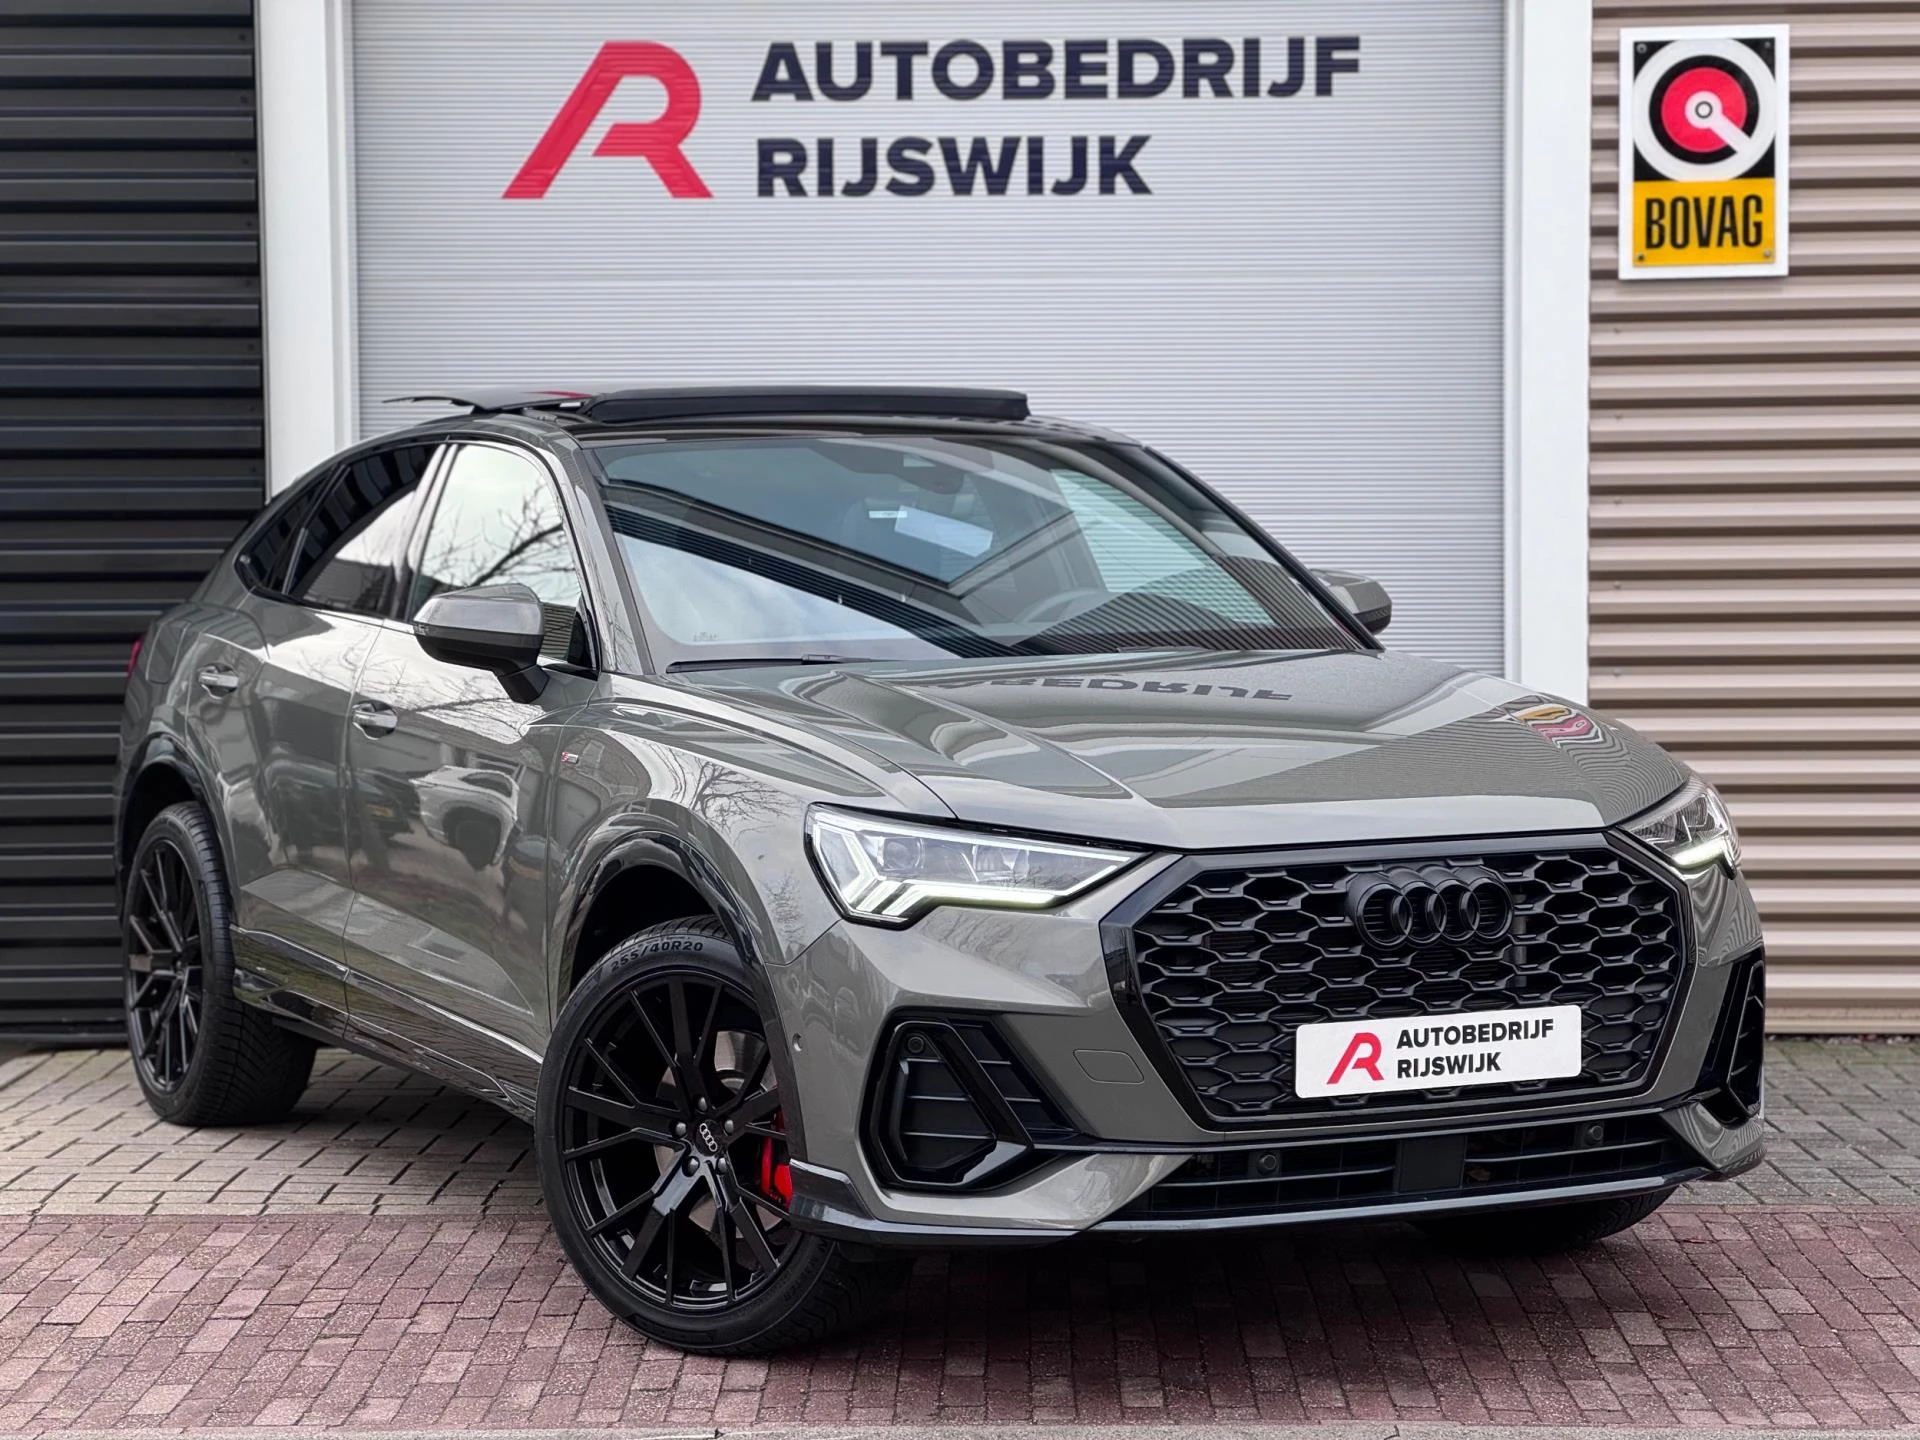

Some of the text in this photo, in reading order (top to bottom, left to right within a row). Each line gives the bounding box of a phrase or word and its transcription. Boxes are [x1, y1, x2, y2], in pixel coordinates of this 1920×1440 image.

[752, 36, 1361, 102] AUTOBEDRIJF
[757, 135, 1153, 198] RIJSWIJK
[1645, 194, 1763, 250] BOVAG
[611, 940, 703, 972] 255/40R20
[1396, 1018, 1554, 1049] AUTOBEDRIJF
[1397, 1051, 1502, 1079] RIJSWIJK
